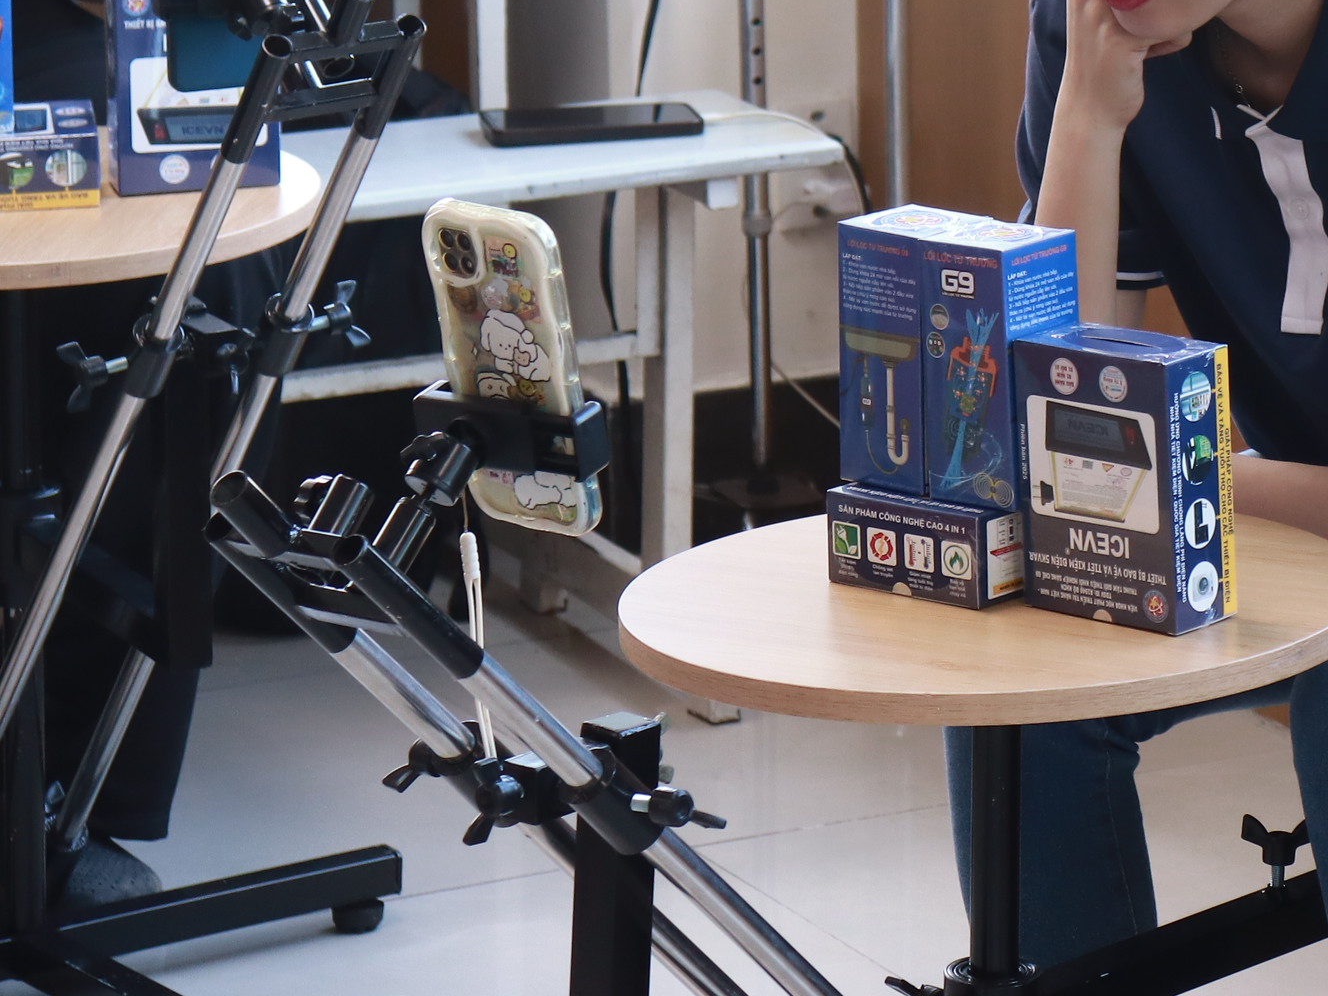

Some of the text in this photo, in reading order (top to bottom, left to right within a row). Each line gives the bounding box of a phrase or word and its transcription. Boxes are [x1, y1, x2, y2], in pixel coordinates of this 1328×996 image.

[941, 269, 974, 294] G9
[838, 503, 966, 535] SẢN PHẨM CÔNG NGHỆ CAO 4 IN 1
[1068, 528, 1130, 559] ICEVN
[1051, 553, 1067, 569] ĐIỆN
[1069, 557, 1085, 573] KIỆM
[1087, 561, 1102, 576] TIẾT
[1103, 565, 1112, 578] VÀ
[1113, 564, 1122, 579] VỆ
[1123, 568, 1137, 582] BẢO
[1138, 569, 1146, 582] BỊ
[1147, 573, 1166, 589] THIẾT
